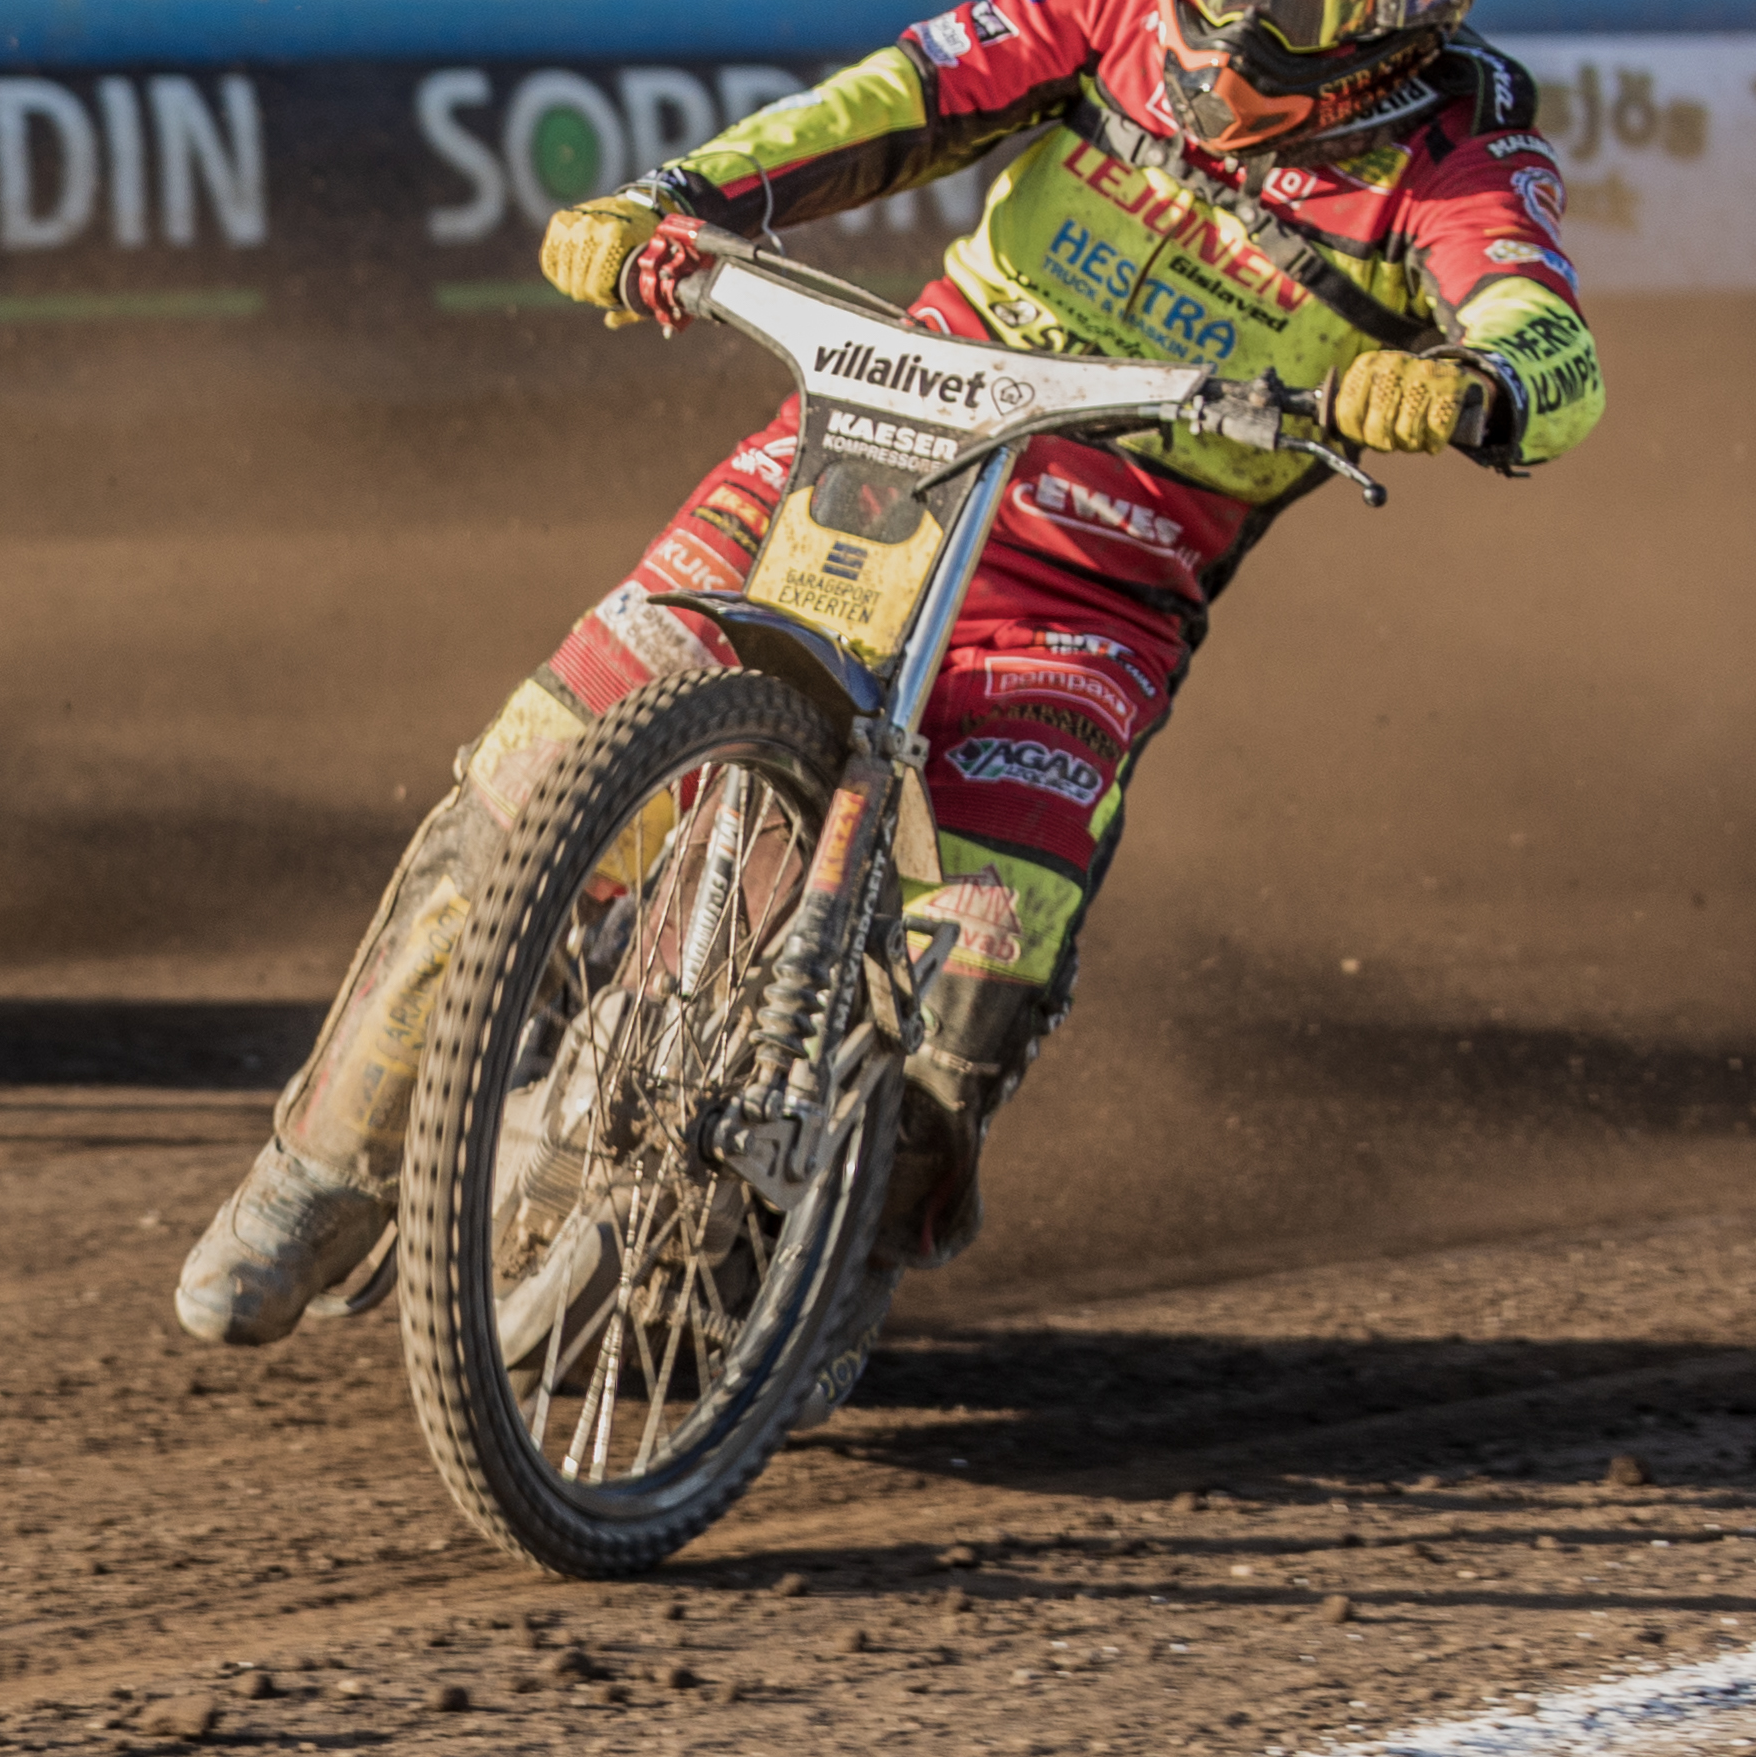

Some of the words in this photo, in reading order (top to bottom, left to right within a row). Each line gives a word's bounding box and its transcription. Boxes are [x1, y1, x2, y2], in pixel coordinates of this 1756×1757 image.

[1063, 140, 1313, 312] LEJONEN
[1043, 254, 1097, 304] TRUCK
[1050, 218, 1237, 360] HESTRA
[1167, 254, 1291, 334] Gislaved
[814, 340, 987, 409] villalivet
[826, 411, 959, 463] KAESER
[777, 585, 875, 625] EXPERTEN
[785, 567, 882, 605] GARAGEPORT
